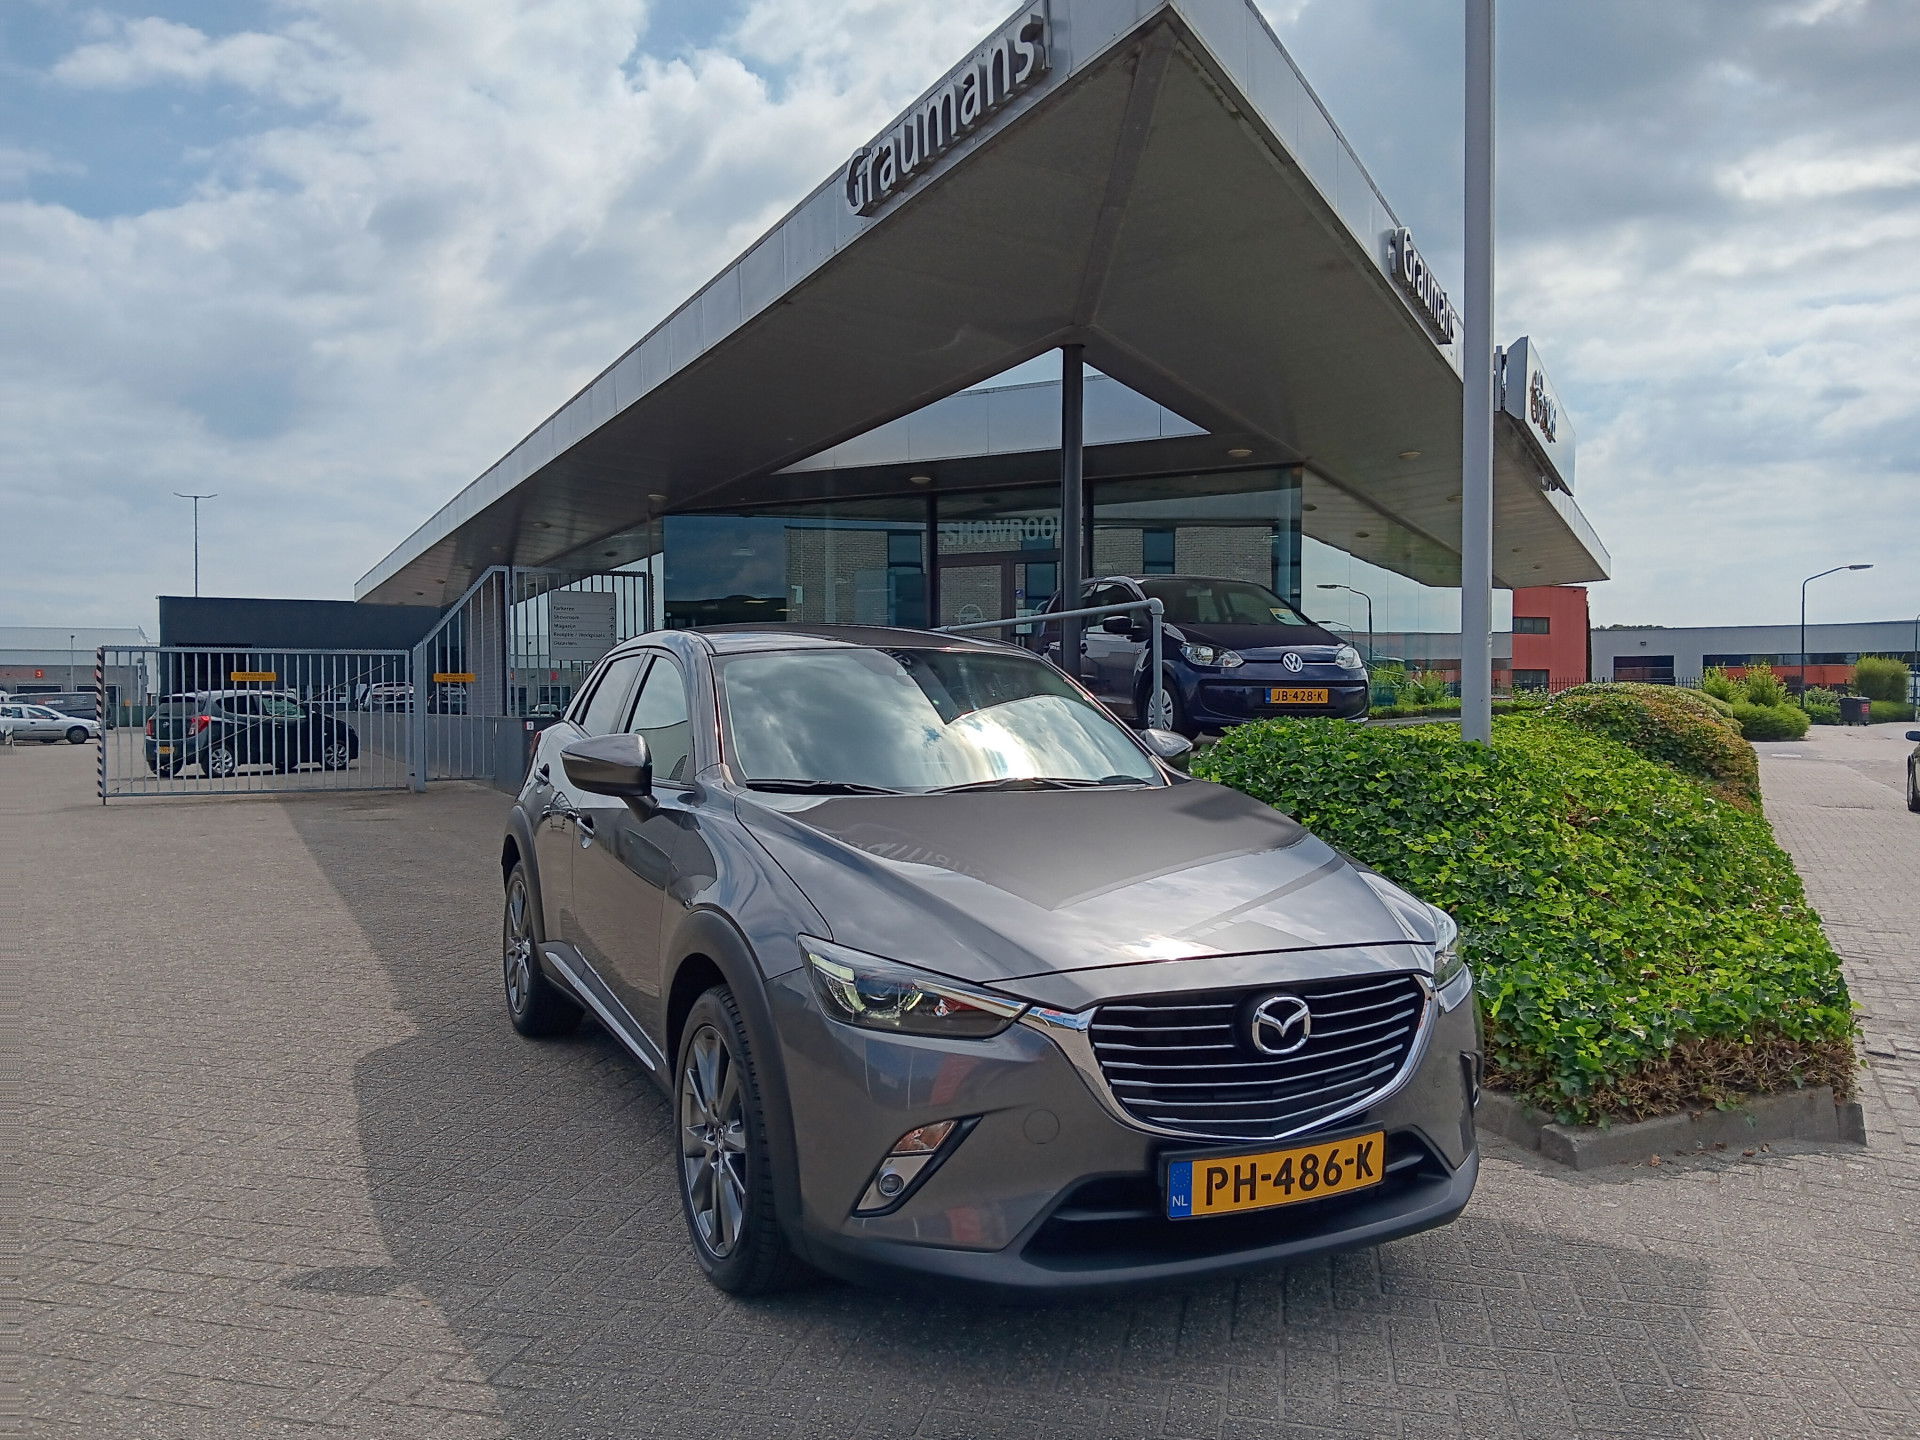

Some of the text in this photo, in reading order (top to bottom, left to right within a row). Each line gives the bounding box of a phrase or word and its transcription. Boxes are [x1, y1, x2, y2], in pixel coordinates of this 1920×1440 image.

[845, 14, 1042, 216] Graumans
[1398, 227, 1457, 344] Graumans
[943, 516, 1062, 546] SHOWROO
[1274, 690, 1324, 702] JB-428-K
[1206, 1141, 1374, 1206] PH-486-K
[1172, 1195, 1188, 1207] NL
